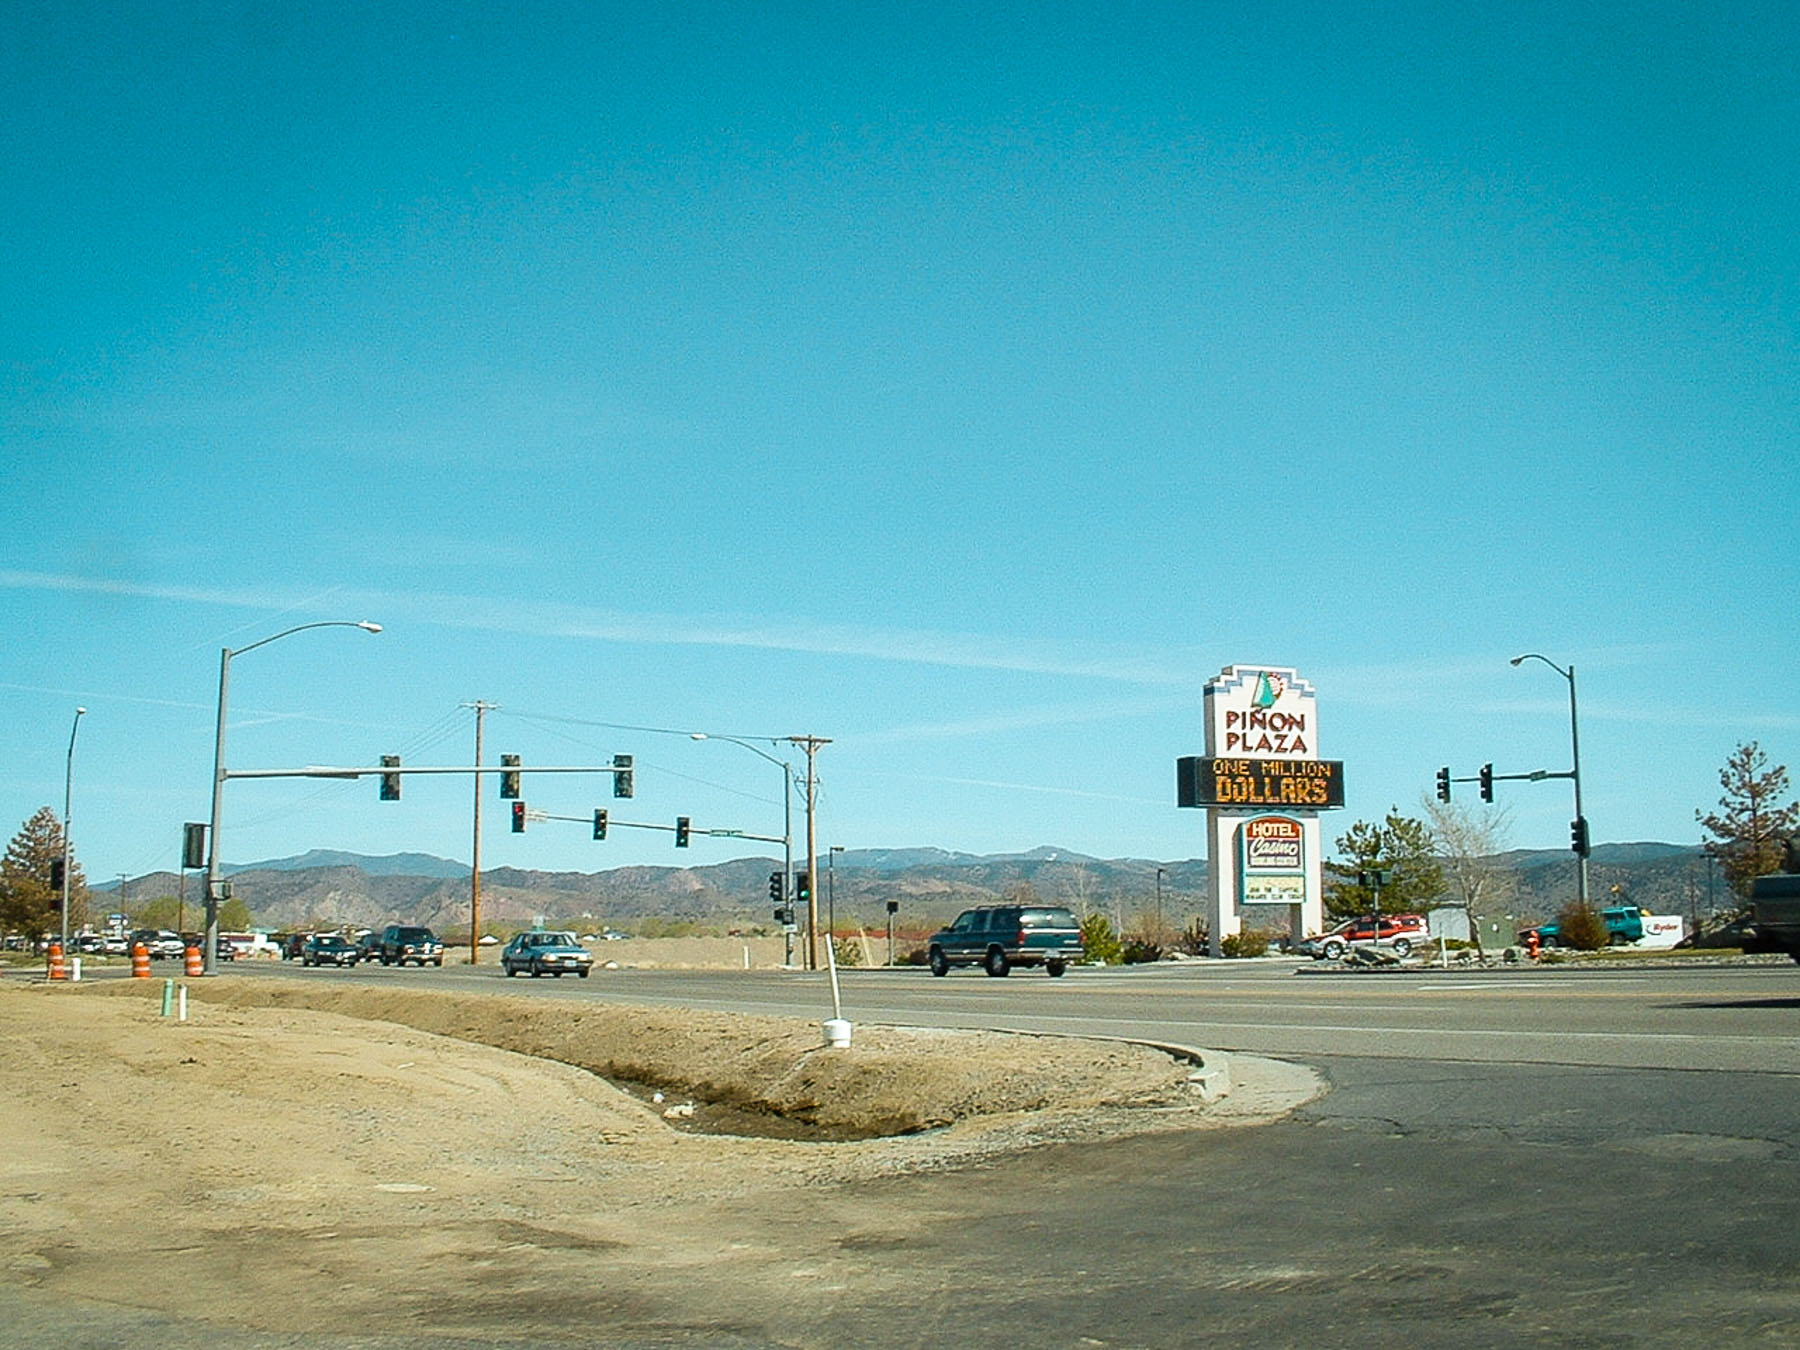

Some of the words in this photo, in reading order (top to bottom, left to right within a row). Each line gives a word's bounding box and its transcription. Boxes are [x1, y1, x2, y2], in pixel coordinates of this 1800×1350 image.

[1226, 732, 1307, 754] PLAZA
[1213, 759, 1250, 775] ONE
[1261, 760, 1331, 777] MILLION
[1216, 776, 1328, 803] DOLLARS
[1252, 823, 1296, 836] HOTEL
[1250, 837, 1299, 856] Casino
